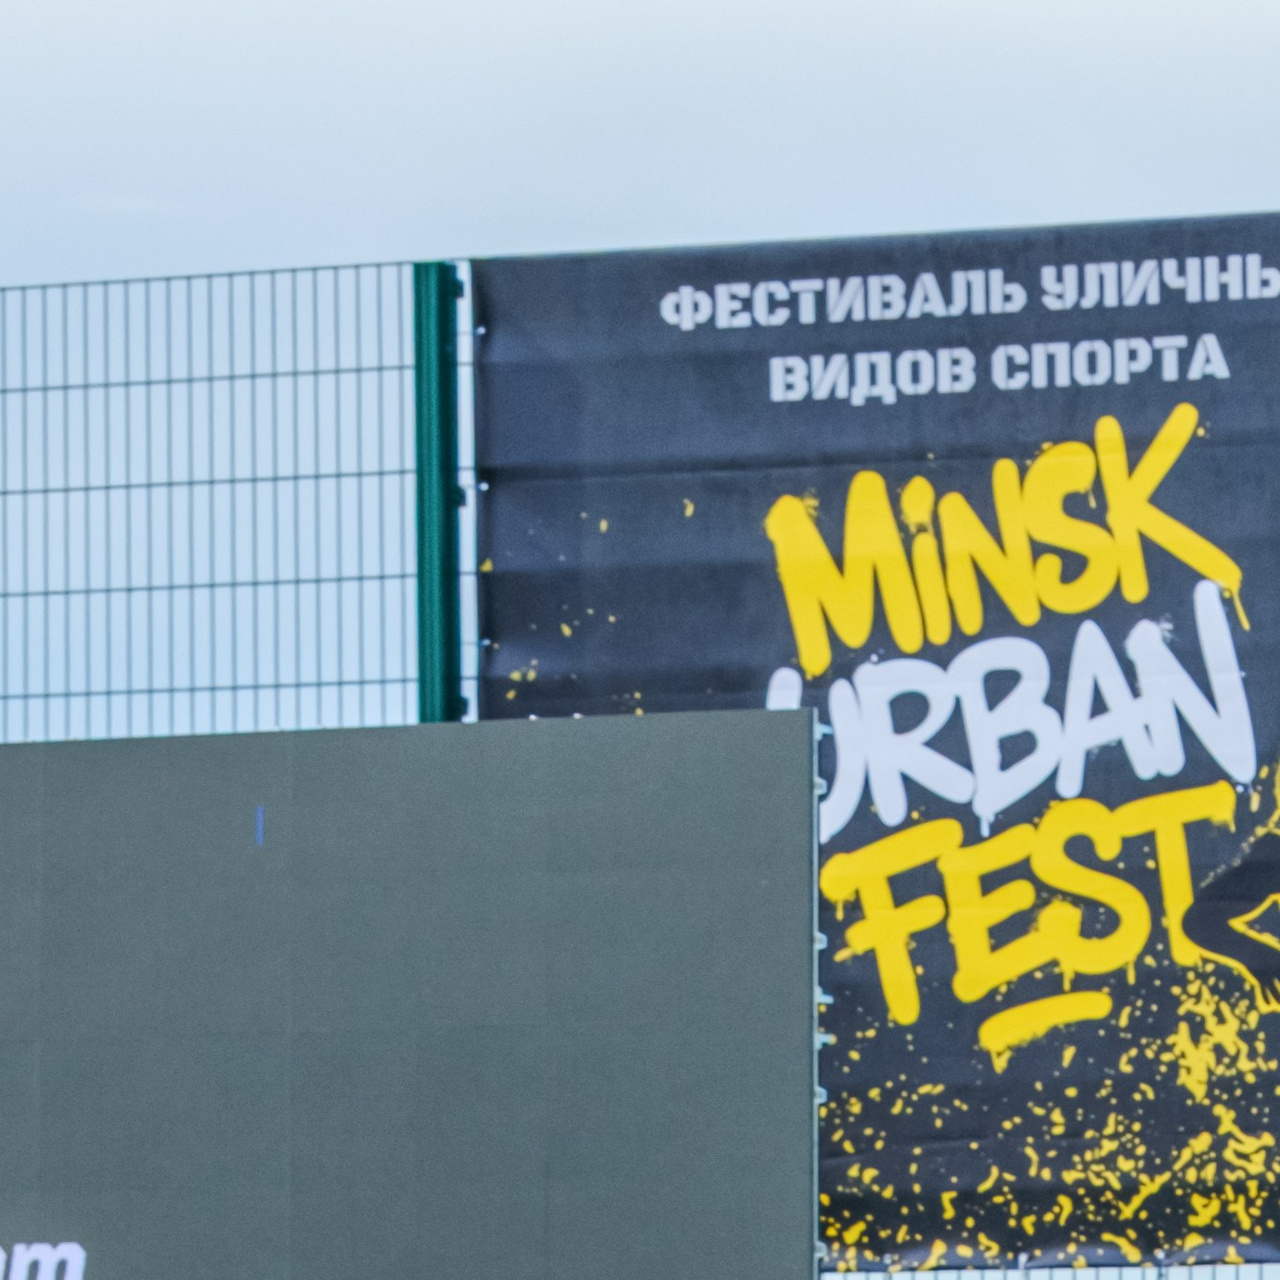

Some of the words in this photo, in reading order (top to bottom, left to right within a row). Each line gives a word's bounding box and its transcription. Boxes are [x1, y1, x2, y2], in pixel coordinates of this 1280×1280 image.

[659, 268, 1027, 331] ФЕСТИВАЛЬ
[769, 346, 976, 406] ВИДОВ
[990, 333, 1231, 391] СПОРТА
[819, 779, 1236, 1025] FEST
